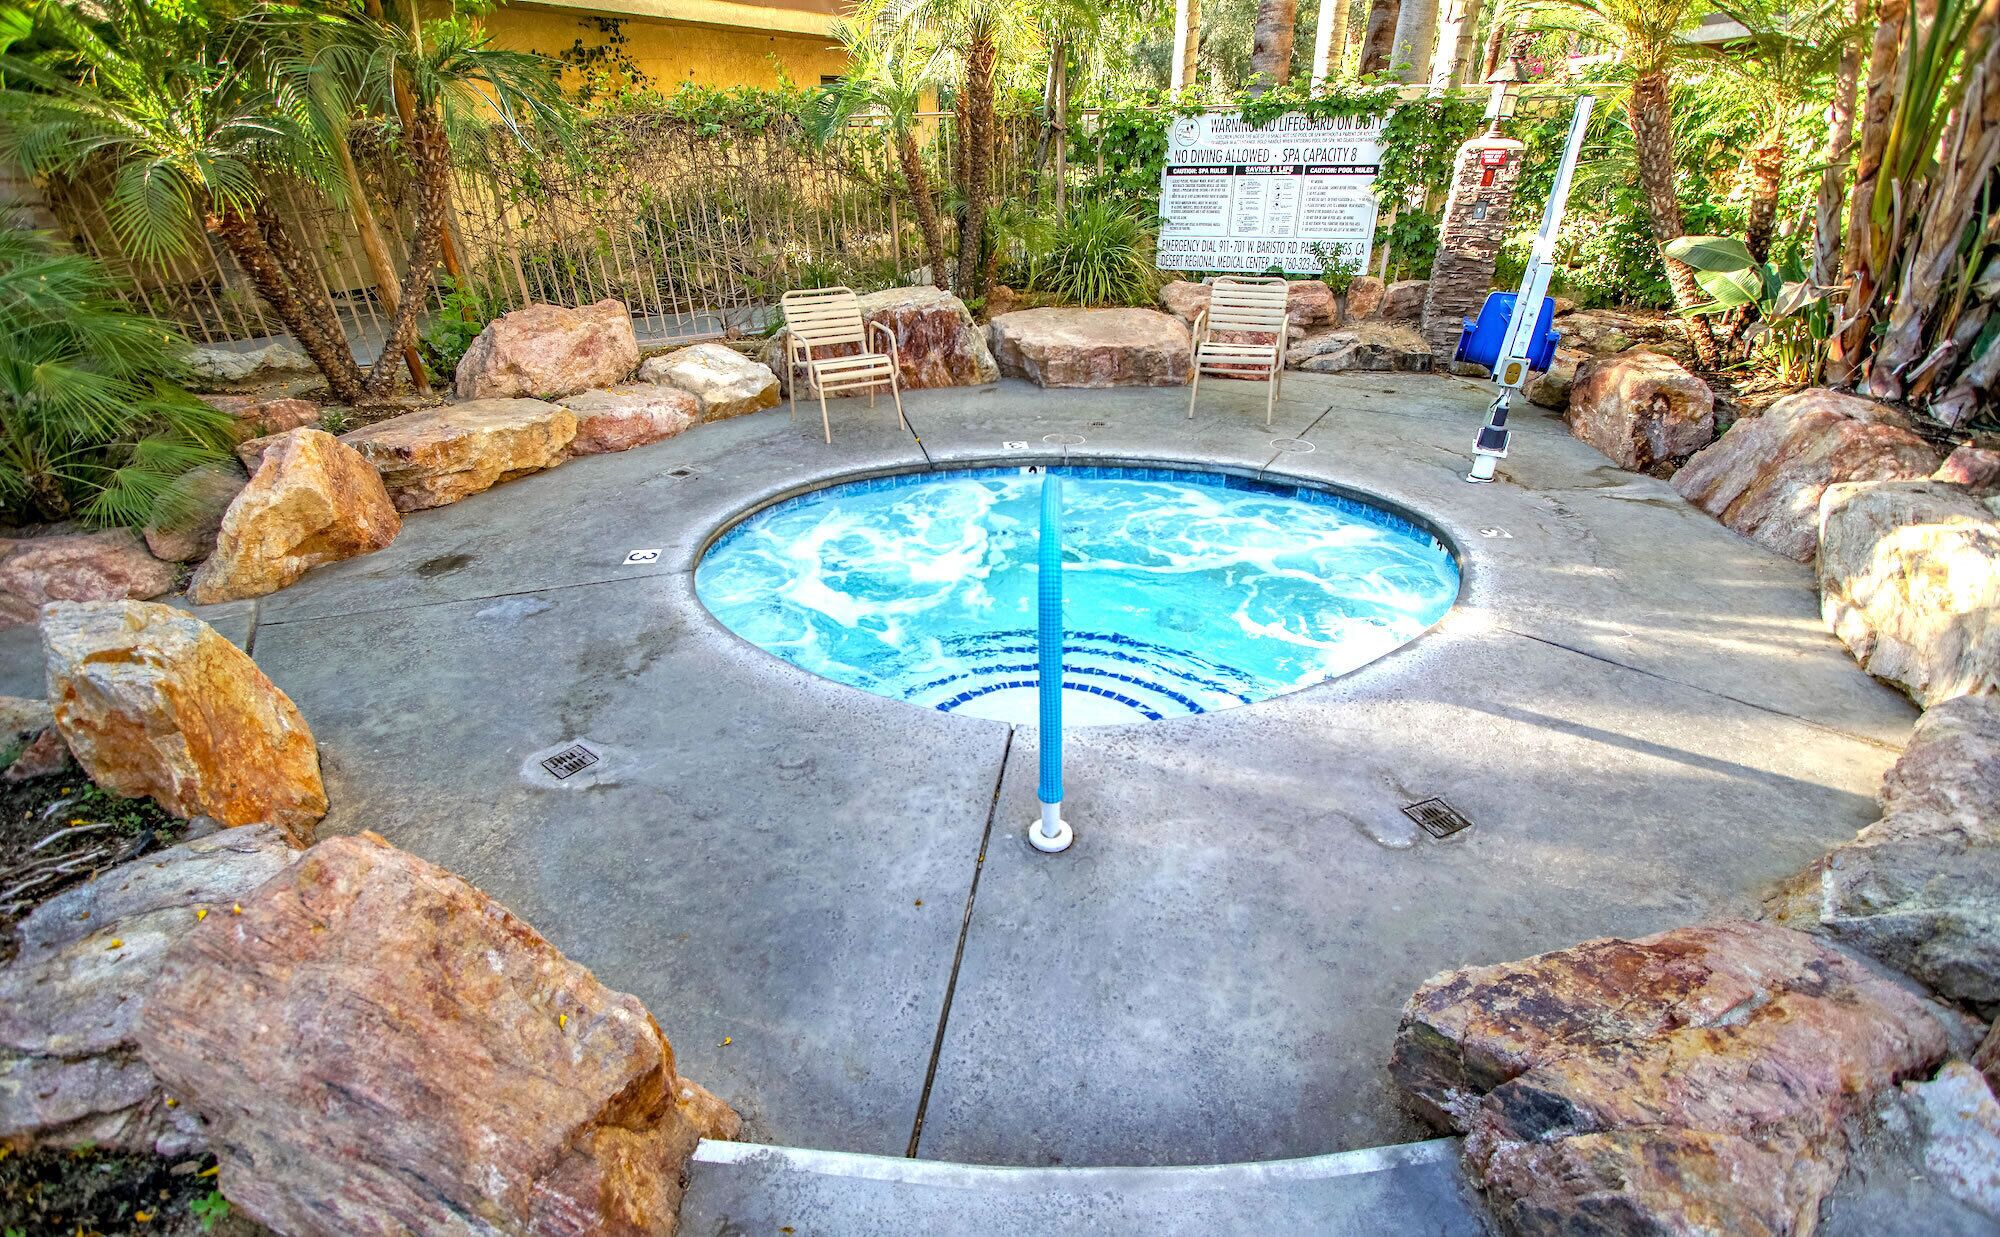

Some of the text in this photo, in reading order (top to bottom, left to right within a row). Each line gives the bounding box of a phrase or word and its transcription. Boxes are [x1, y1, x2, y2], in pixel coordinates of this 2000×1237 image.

[1211, 118, 1258, 133] WARNING
[1262, 119, 1276, 132] NO
[1279, 116, 1334, 131] LIFEGUARD
[1337, 115, 1353, 130] ON
[1174, 147, 1358, 163] NO DIVING ALLOWED SPA CAPACITY 8
[1245, 165, 1294, 173] SAVING A LIFE
[1161, 239, 1200, 252] EMERGENCY
[1201, 240, 1216, 252] DIAL
[1247, 241, 1255, 253] W.
[1256, 241, 1286, 254] BARISTO
[1286, 242, 1298, 254] RD.
[1300, 242, 1320, 255] PAL
[1321, 242, 1353, 256] SPRGS,
[1355, 243, 1365, 255] CA
[1160, 254, 1183, 267] DESERT
[1184, 255, 1215, 268] REGIONAL
[1216, 256, 1244, 269] MEDICAL
[1245, 256, 1270, 270] CENTER
[628, 553, 657, 561] 3
